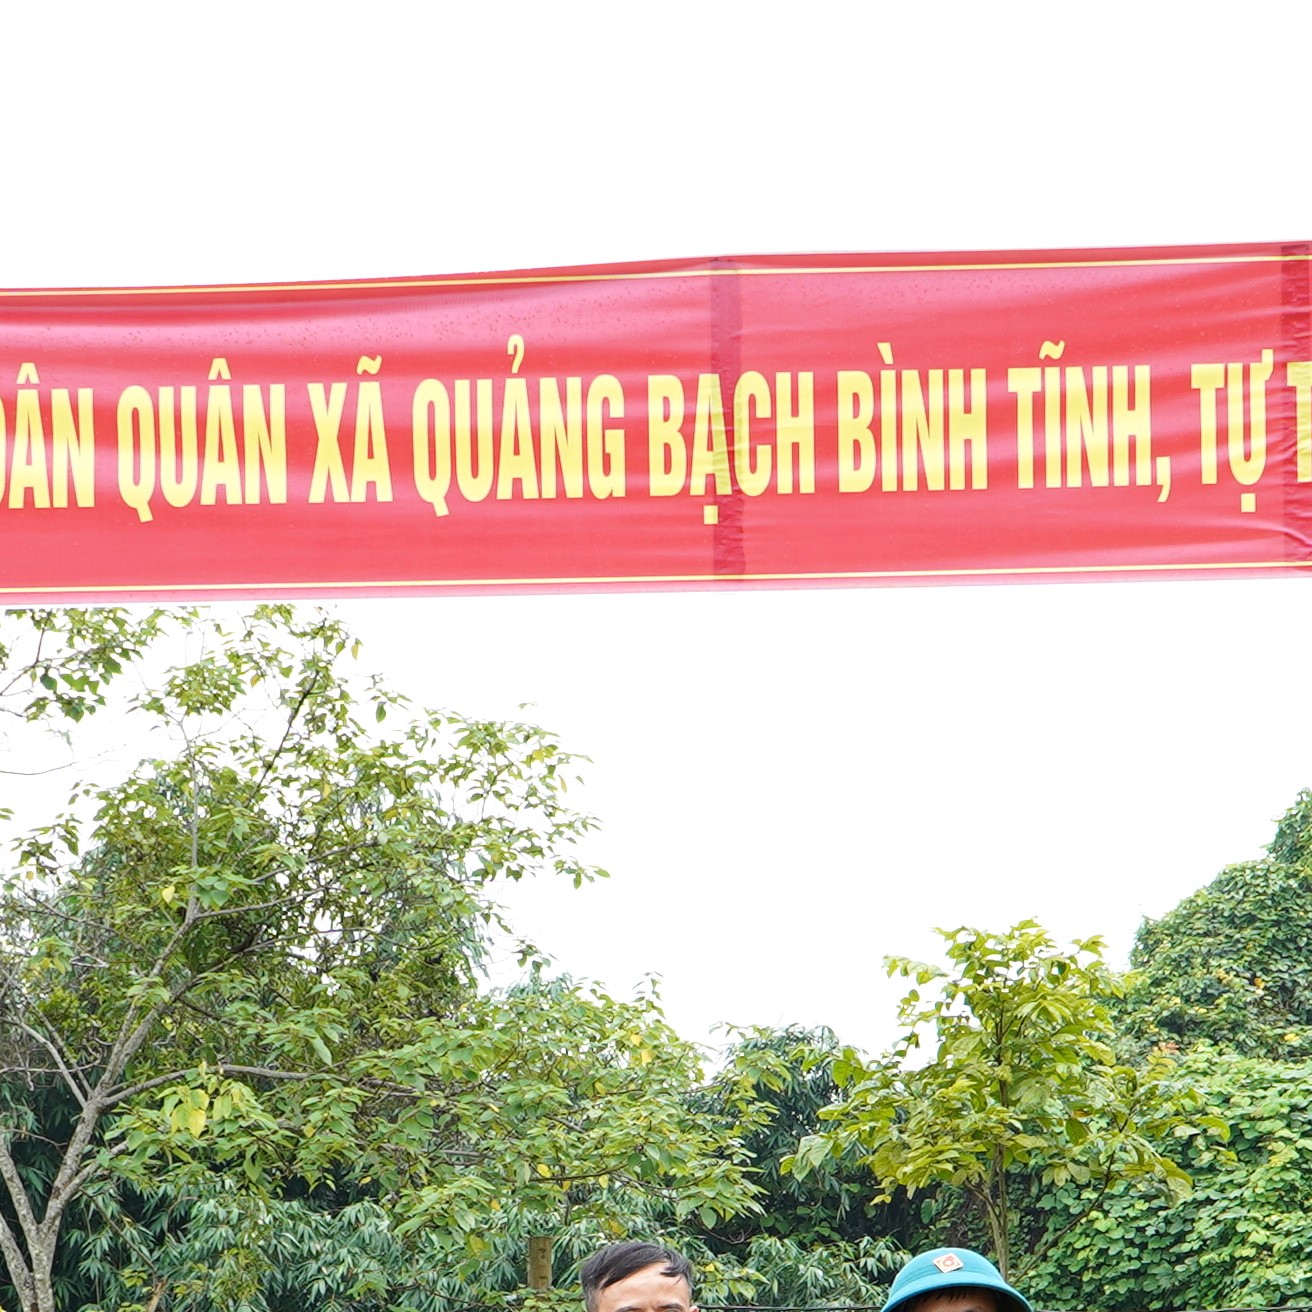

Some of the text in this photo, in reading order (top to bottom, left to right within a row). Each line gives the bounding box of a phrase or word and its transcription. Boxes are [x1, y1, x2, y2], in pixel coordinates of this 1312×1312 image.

[117, 357, 287, 523] QUÂN
[308, 355, 392, 504] XÃ
[413, 334, 626, 516] QUẢNG
[648, 370, 816, 525] BẠCH
[838, 342, 988, 494] BÌNH
[1008, 340, 1171, 503] TĨNH,
[1191, 349, 1274, 513] TỰ
